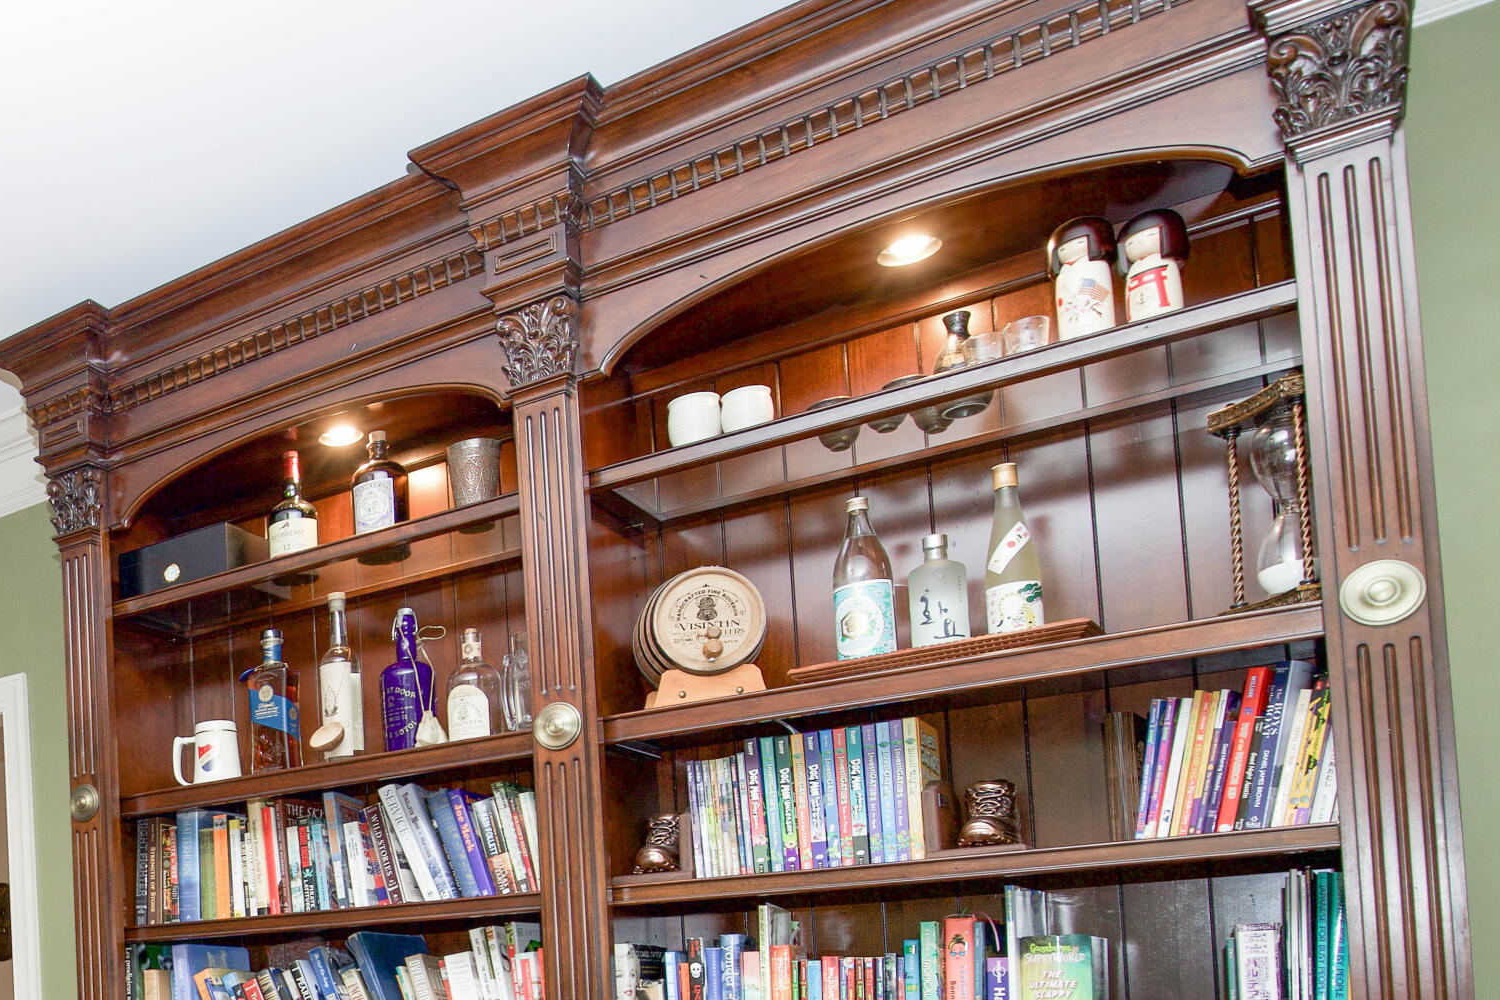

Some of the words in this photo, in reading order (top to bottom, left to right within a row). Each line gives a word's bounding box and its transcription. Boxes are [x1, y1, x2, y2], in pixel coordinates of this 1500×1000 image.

[677, 589, 706, 621] HANDCRAFTED
[722, 593, 738, 617] BOURBON
[395, 687, 417, 699] DOOR
[1247, 674, 1258, 698] WILLINK
[1262, 704, 1275, 738] BOAT
[1270, 702, 1284, 736] BOYS
[850, 758, 862, 775] DOG
[1249, 752, 1258, 765] Good
[1258, 749, 1271, 770] DANIEL
[748, 768, 759, 785] DOG
[778, 767, 790, 783] DOG
[807, 763, 819, 781] DOG
[867, 752, 878, 801] InvestiGATORS
[893, 748, 904, 797] InvestiGATORS
[1244, 765, 1256, 780] Night
[1256, 770, 1267, 786] JAMES
[1242, 780, 1252, 799] Austin
[1253, 786, 1265, 808] BROWN
[285, 804, 306, 817] THE
[383, 787, 409, 834] SERVICE
[453, 803, 466, 823] Joe
[482, 812, 492, 828] KEN
[370, 813, 382, 839] WILD
[376, 839, 394, 877] STORIES
[459, 823, 476, 853] Meek
[484, 827, 499, 856] FOLLETT
[150, 891, 158, 913] STONE
[1318, 884, 1327, 923] JAPANESE
[1318, 925, 1327, 942] FOR
[124, 947, 132, 959] Les
[1318, 943, 1327, 964] BUSY
[1335, 947, 1344, 966] BUSY
[722, 945, 740, 986] yonder
[1042, 970, 1064, 980] THE
[124, 959, 133, 995] prodigieux
[257, 974, 271, 992] JACK
[922, 959, 933, 998] TROPICAL
[1029, 980, 1078, 990] ULTIMATE
[1318, 965, 1327, 996] PEOPLE
[1335, 968, 1345, 999] PEOPLE
[1035, 989, 1073, 1000] SLAPPY
